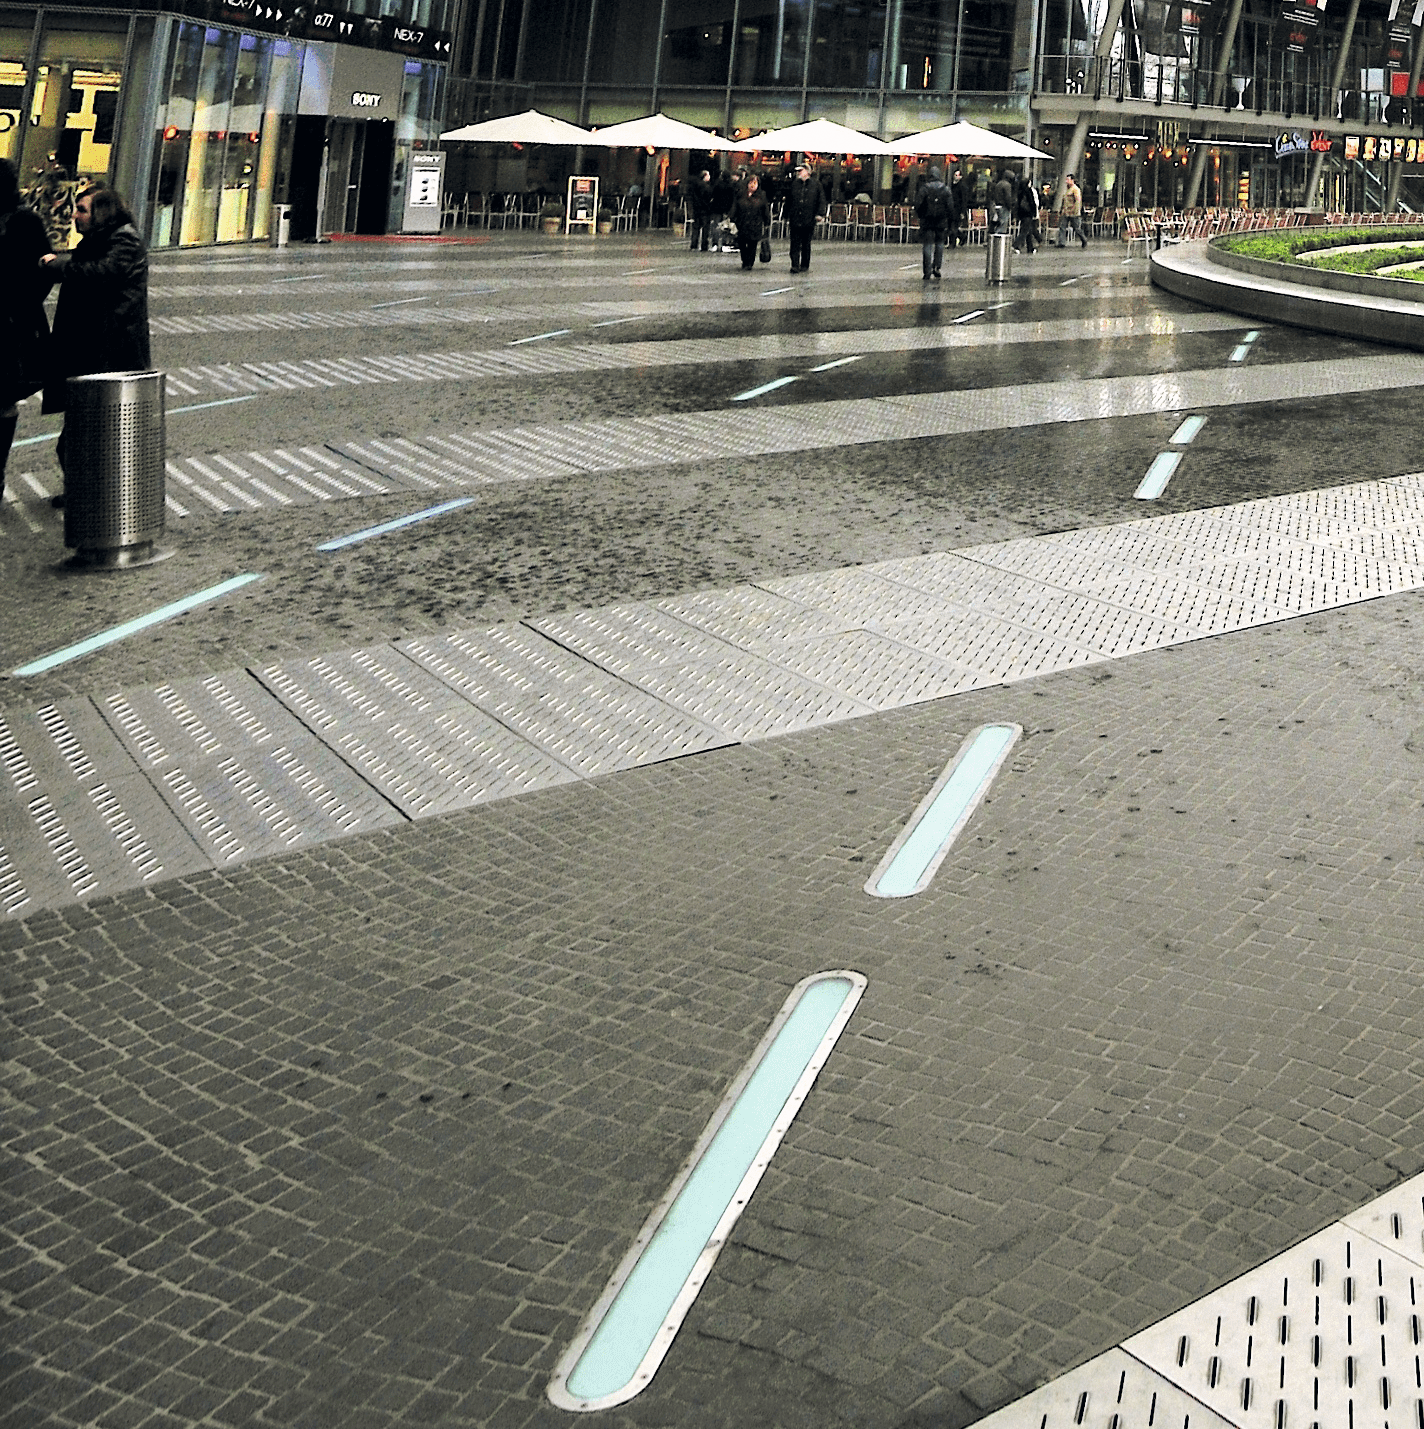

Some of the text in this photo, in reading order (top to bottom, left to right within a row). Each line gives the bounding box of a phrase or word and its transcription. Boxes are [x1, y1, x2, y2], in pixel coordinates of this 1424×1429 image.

[393, 27, 424, 43] NEX-7
[353, 92, 380, 106] SONY
[413, 155, 441, 163] SONY
